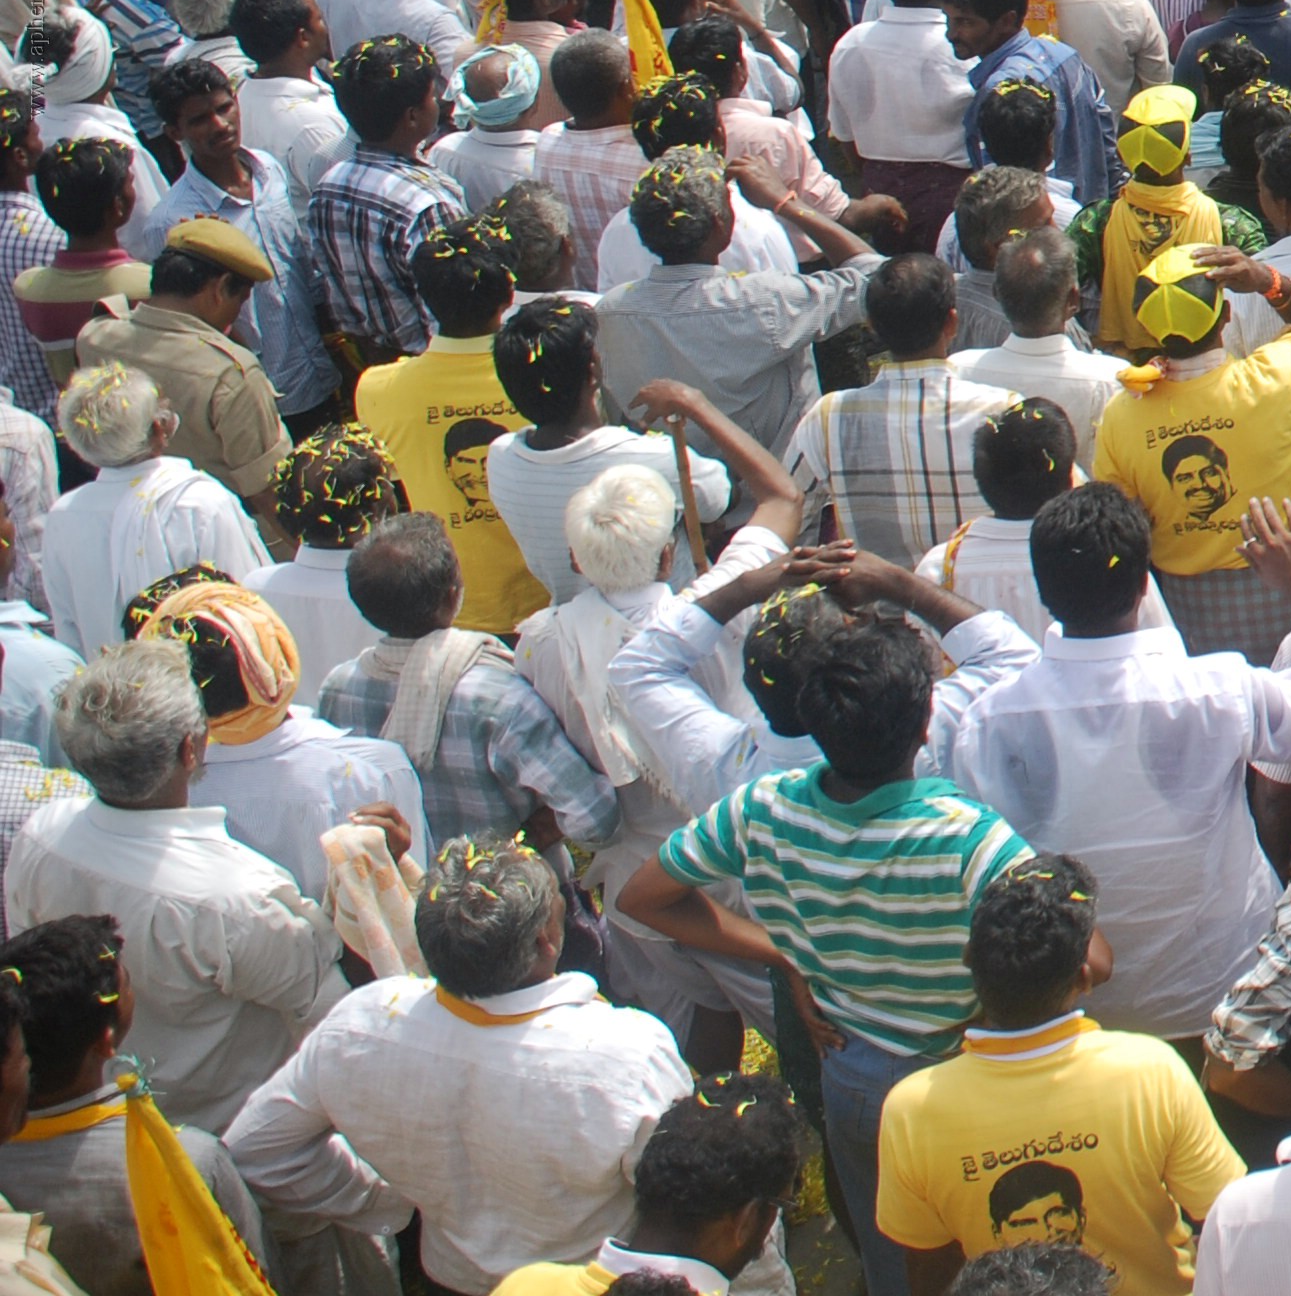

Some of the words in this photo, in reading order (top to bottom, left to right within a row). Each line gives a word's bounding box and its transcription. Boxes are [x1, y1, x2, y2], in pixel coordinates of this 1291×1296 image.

[1158, 415, 1236, 441] తెలుగుదేశం
[960, 1154, 981, 1183] జై
[981, 1130, 1101, 1171] తెలుగుదేశం
